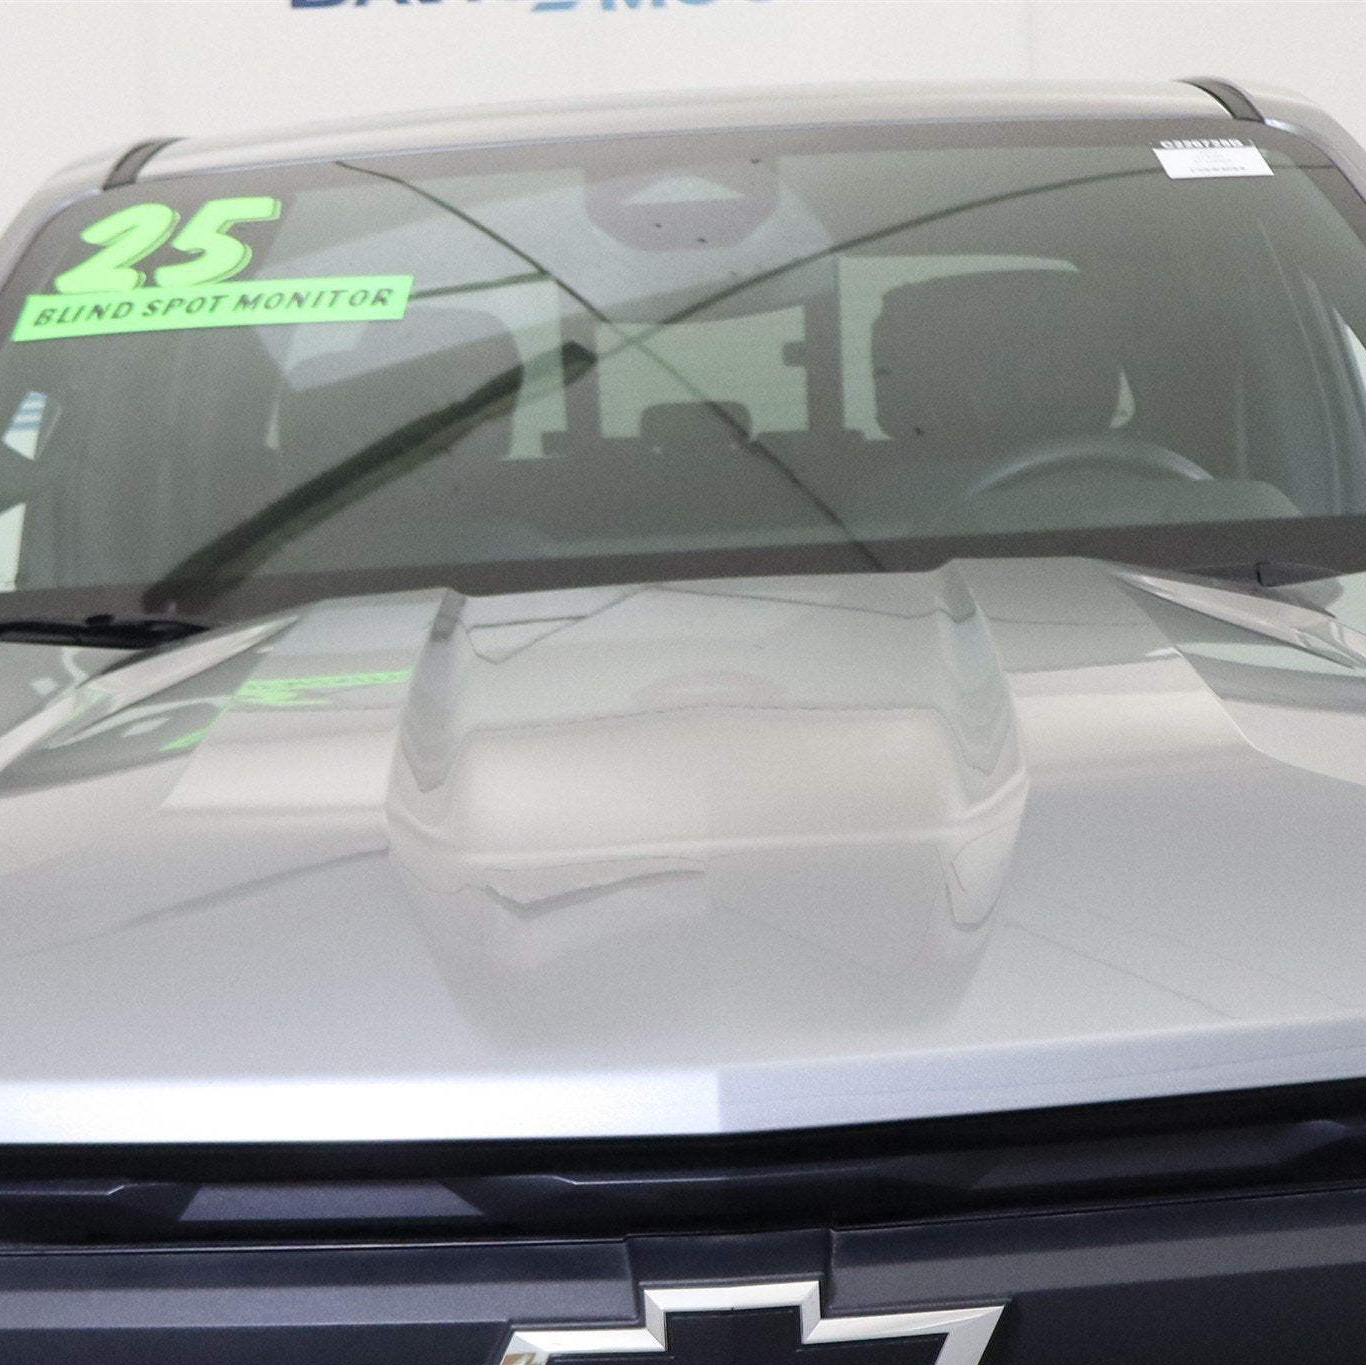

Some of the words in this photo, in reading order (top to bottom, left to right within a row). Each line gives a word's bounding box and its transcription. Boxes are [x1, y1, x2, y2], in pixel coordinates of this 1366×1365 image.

[55, 197, 282, 293] 25
[33, 301, 134, 327] BLIND
[142, 295, 232, 319] SPOT
[232, 287, 395, 313] MONITOR
